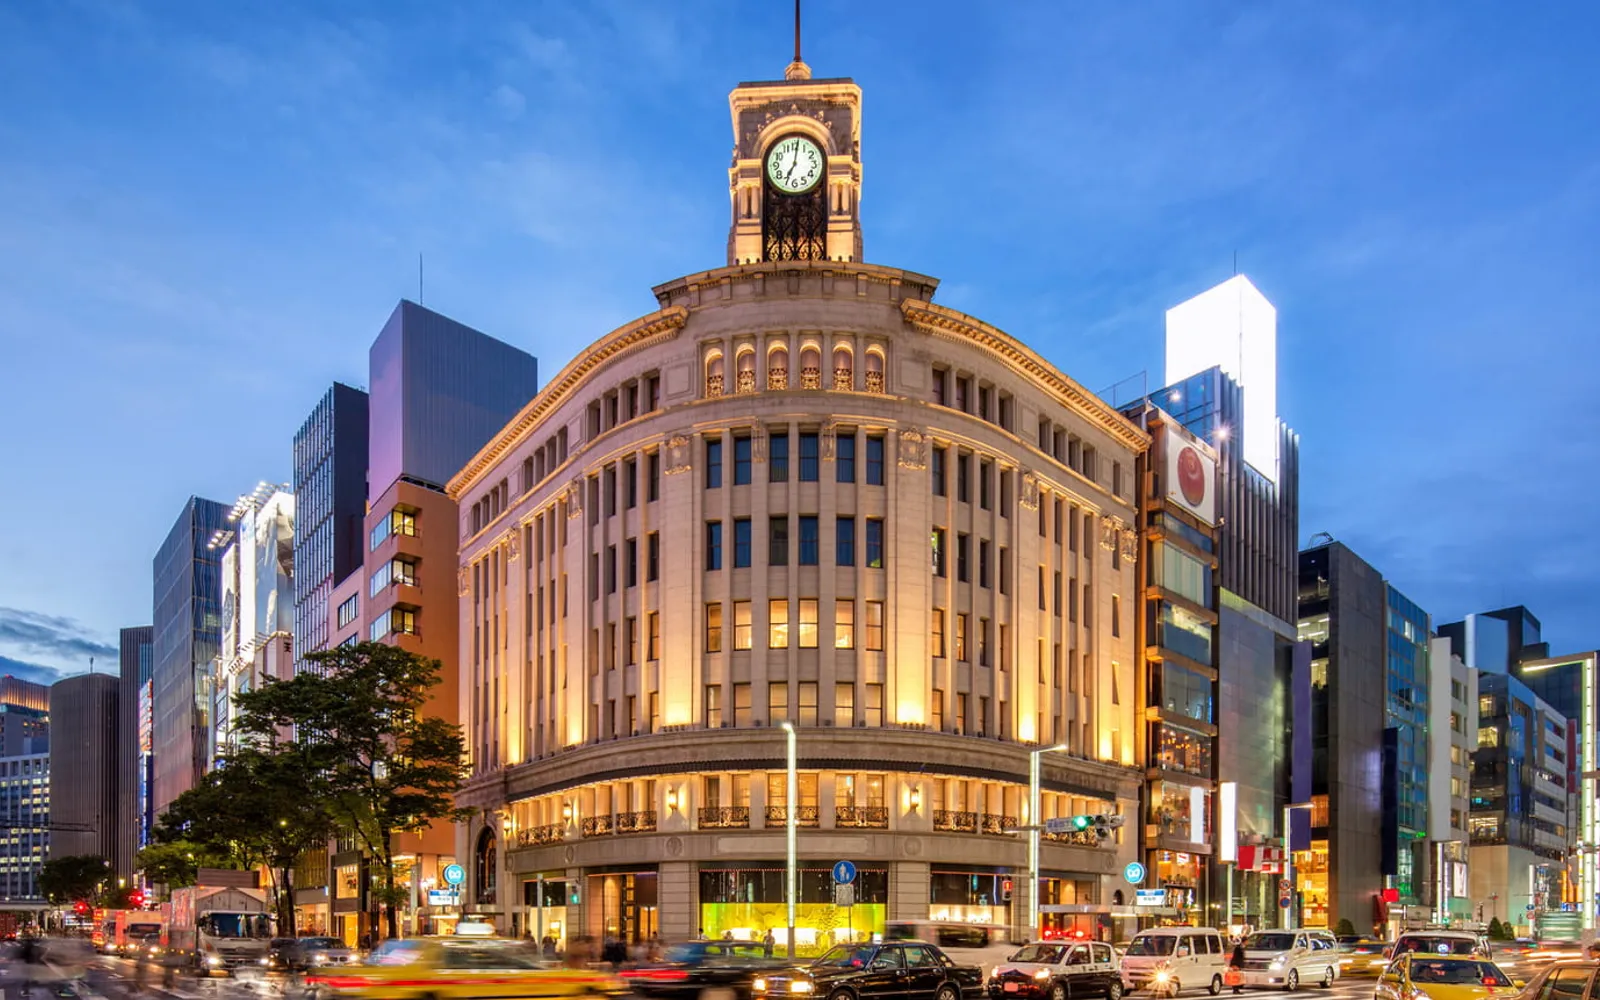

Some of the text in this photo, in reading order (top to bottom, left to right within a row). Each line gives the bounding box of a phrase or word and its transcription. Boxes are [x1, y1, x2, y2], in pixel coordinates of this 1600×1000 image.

[784, 144, 790, 153] 11
[803, 144, 806, 153] 1
[776, 152, 783, 161] 10
[808, 150, 814, 159] 2
[773, 162, 779, 170] 9
[812, 160, 817, 169] 3
[776, 170, 782, 179] 8
[808, 170, 814, 178] 4
[784, 176, 790, 186] 7
[791, 179, 798, 188] 6
[800, 177, 807, 185] 5
